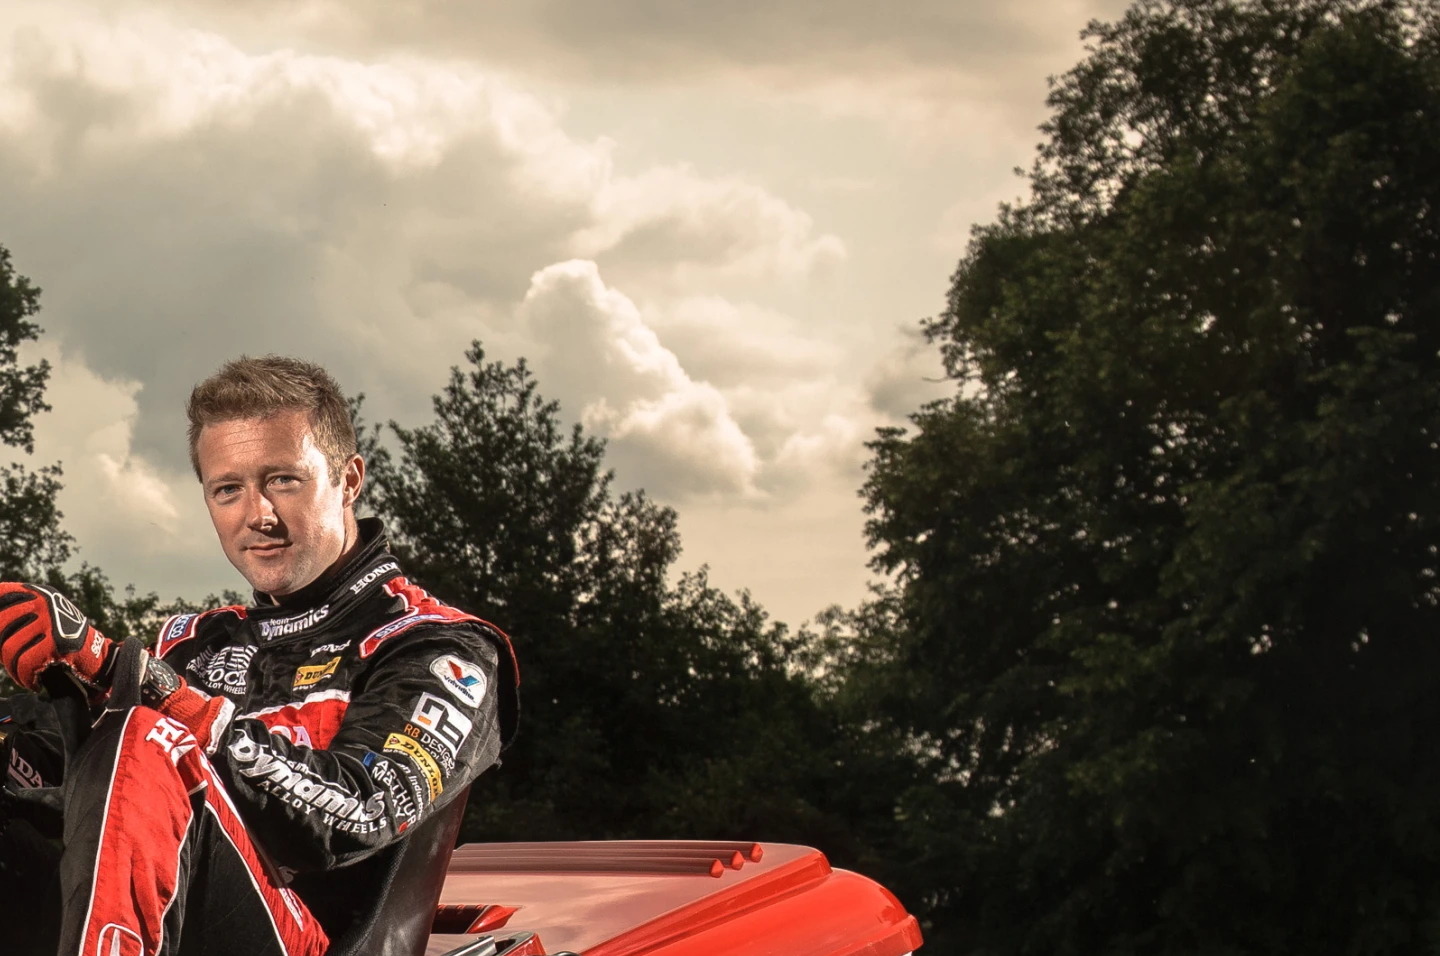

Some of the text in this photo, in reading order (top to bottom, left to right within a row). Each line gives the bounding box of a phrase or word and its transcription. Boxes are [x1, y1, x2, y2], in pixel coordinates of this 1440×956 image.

[404, 723, 421, 738] RB
[257, 780, 387, 834] ALLOY WHEELS
